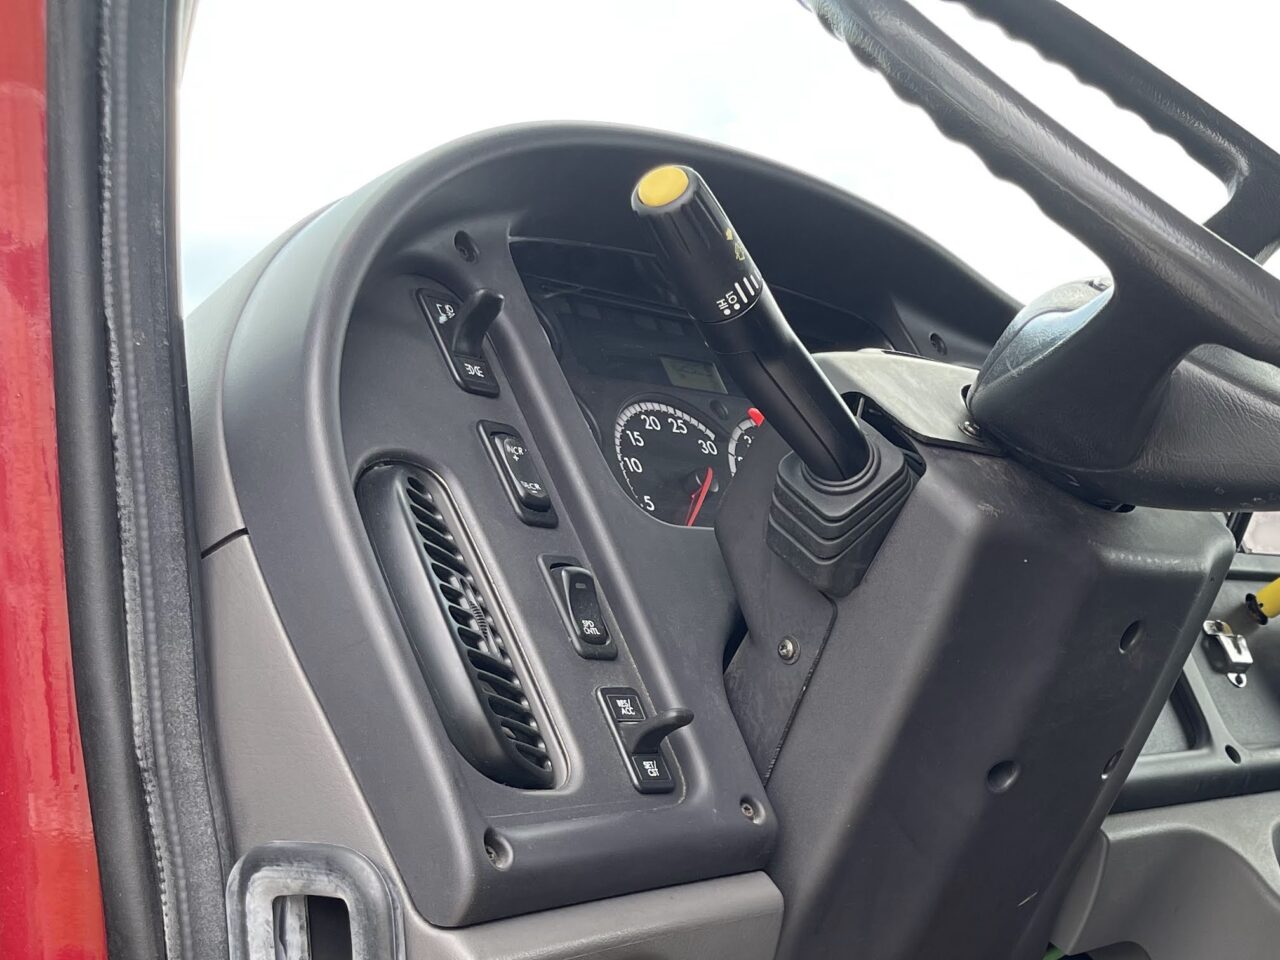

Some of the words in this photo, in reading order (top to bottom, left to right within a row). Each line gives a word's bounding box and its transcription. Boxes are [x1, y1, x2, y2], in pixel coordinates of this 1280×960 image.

[716, 298, 729, 310] HI
[725, 290, 738, 304] LO
[641, 414, 661, 431] 20
[668, 417, 688, 434] 25
[626, 430, 645, 447] 15
[698, 439, 718, 455] 30
[623, 457, 643, 473] 10
[643, 495, 655, 511] 5
[582, 619, 595, 628] SPD
